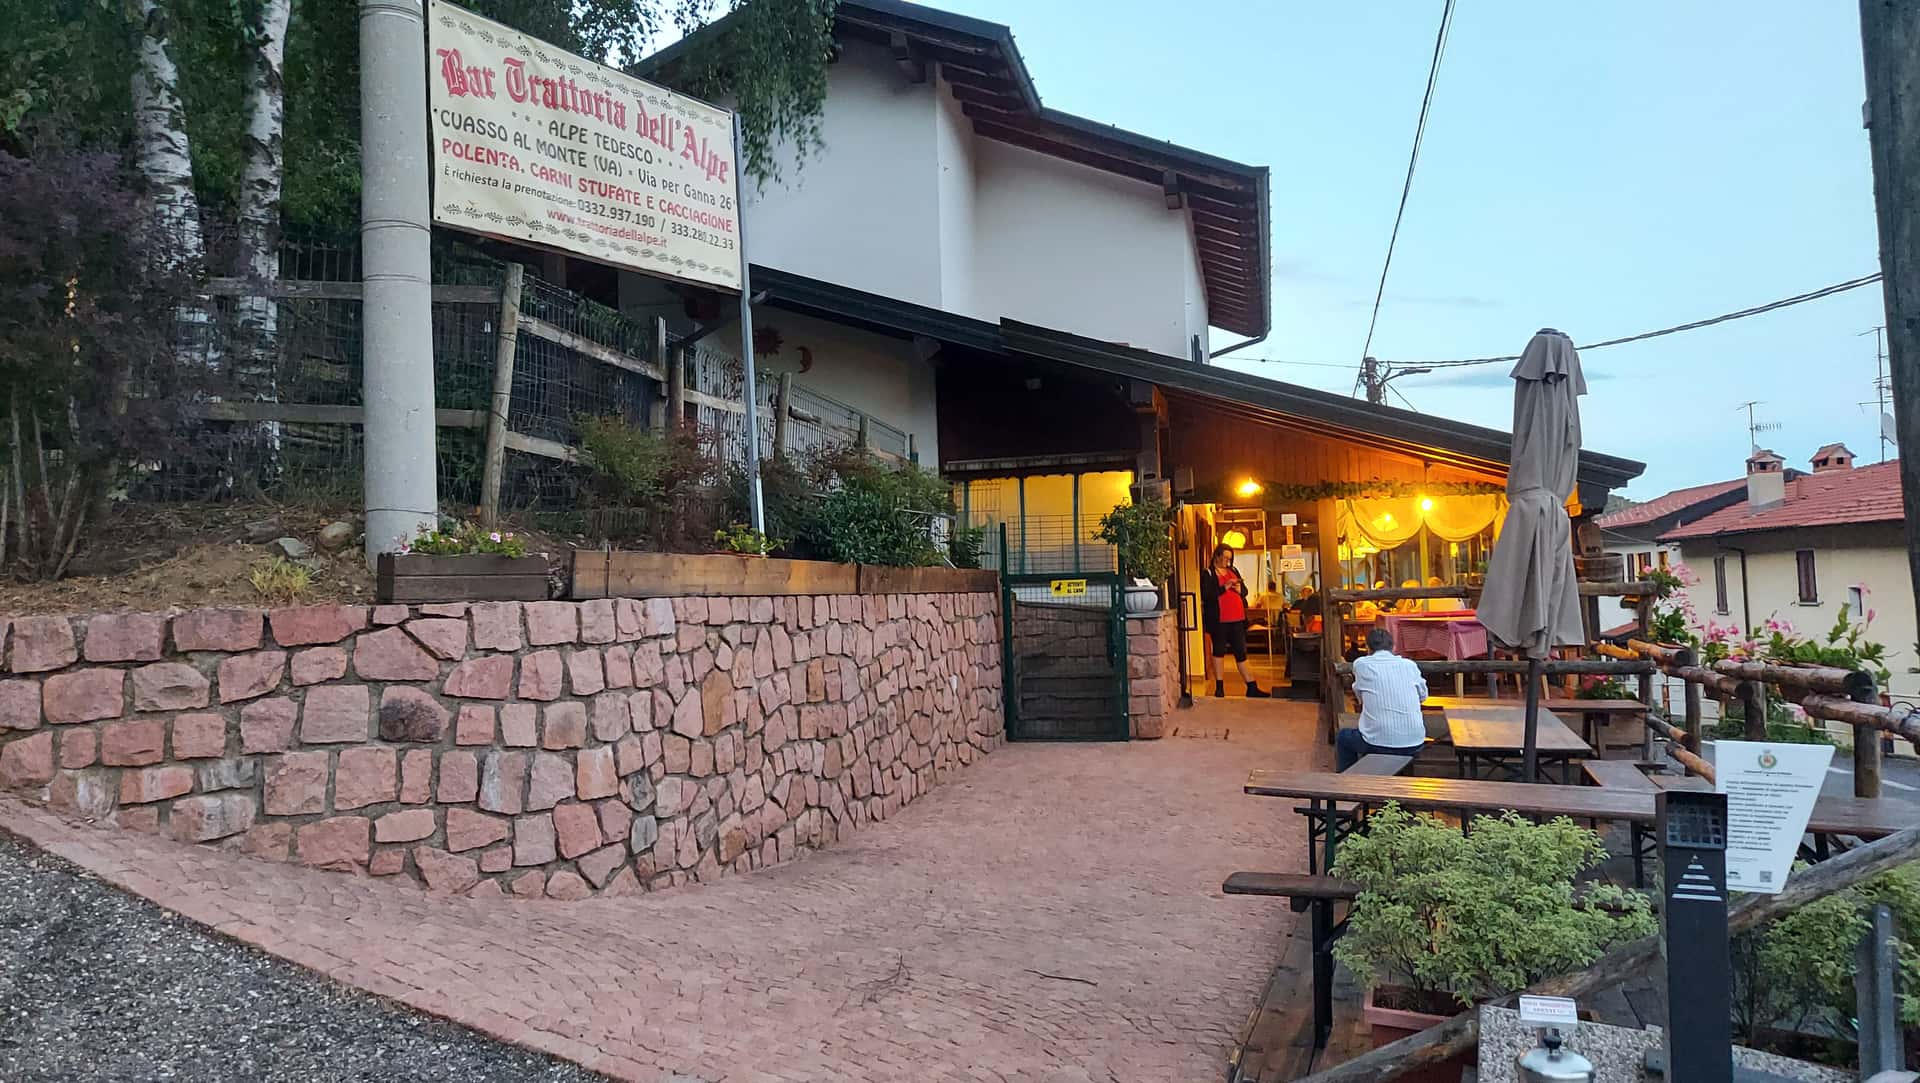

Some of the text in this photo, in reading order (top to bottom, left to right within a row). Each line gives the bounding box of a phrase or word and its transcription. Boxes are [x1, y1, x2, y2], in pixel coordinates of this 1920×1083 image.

[436, 48, 729, 185] Bar Trattoria dell'Alpe
[548, 120, 653, 165] ALPE TEDESCO
[440, 109, 508, 142] CUASSO
[513, 131, 531, 151] AL
[536, 138, 588, 168] MONTE
[594, 154, 622, 178] (VA)
[638, 168, 657, 188] Via
[662, 178, 680, 194] per
[683, 183, 716, 206] Ganna
[452, 168, 499, 188] richiesta
[502, 178, 512, 190] la
[577, 199, 656, 229] 0332.937.190
[530, 162, 573, 189] CARNI
[578, 177, 641, 206] STUFATE
[646, 195, 655, 210] E
[659, 199, 733, 233] CACCIAGIONE
